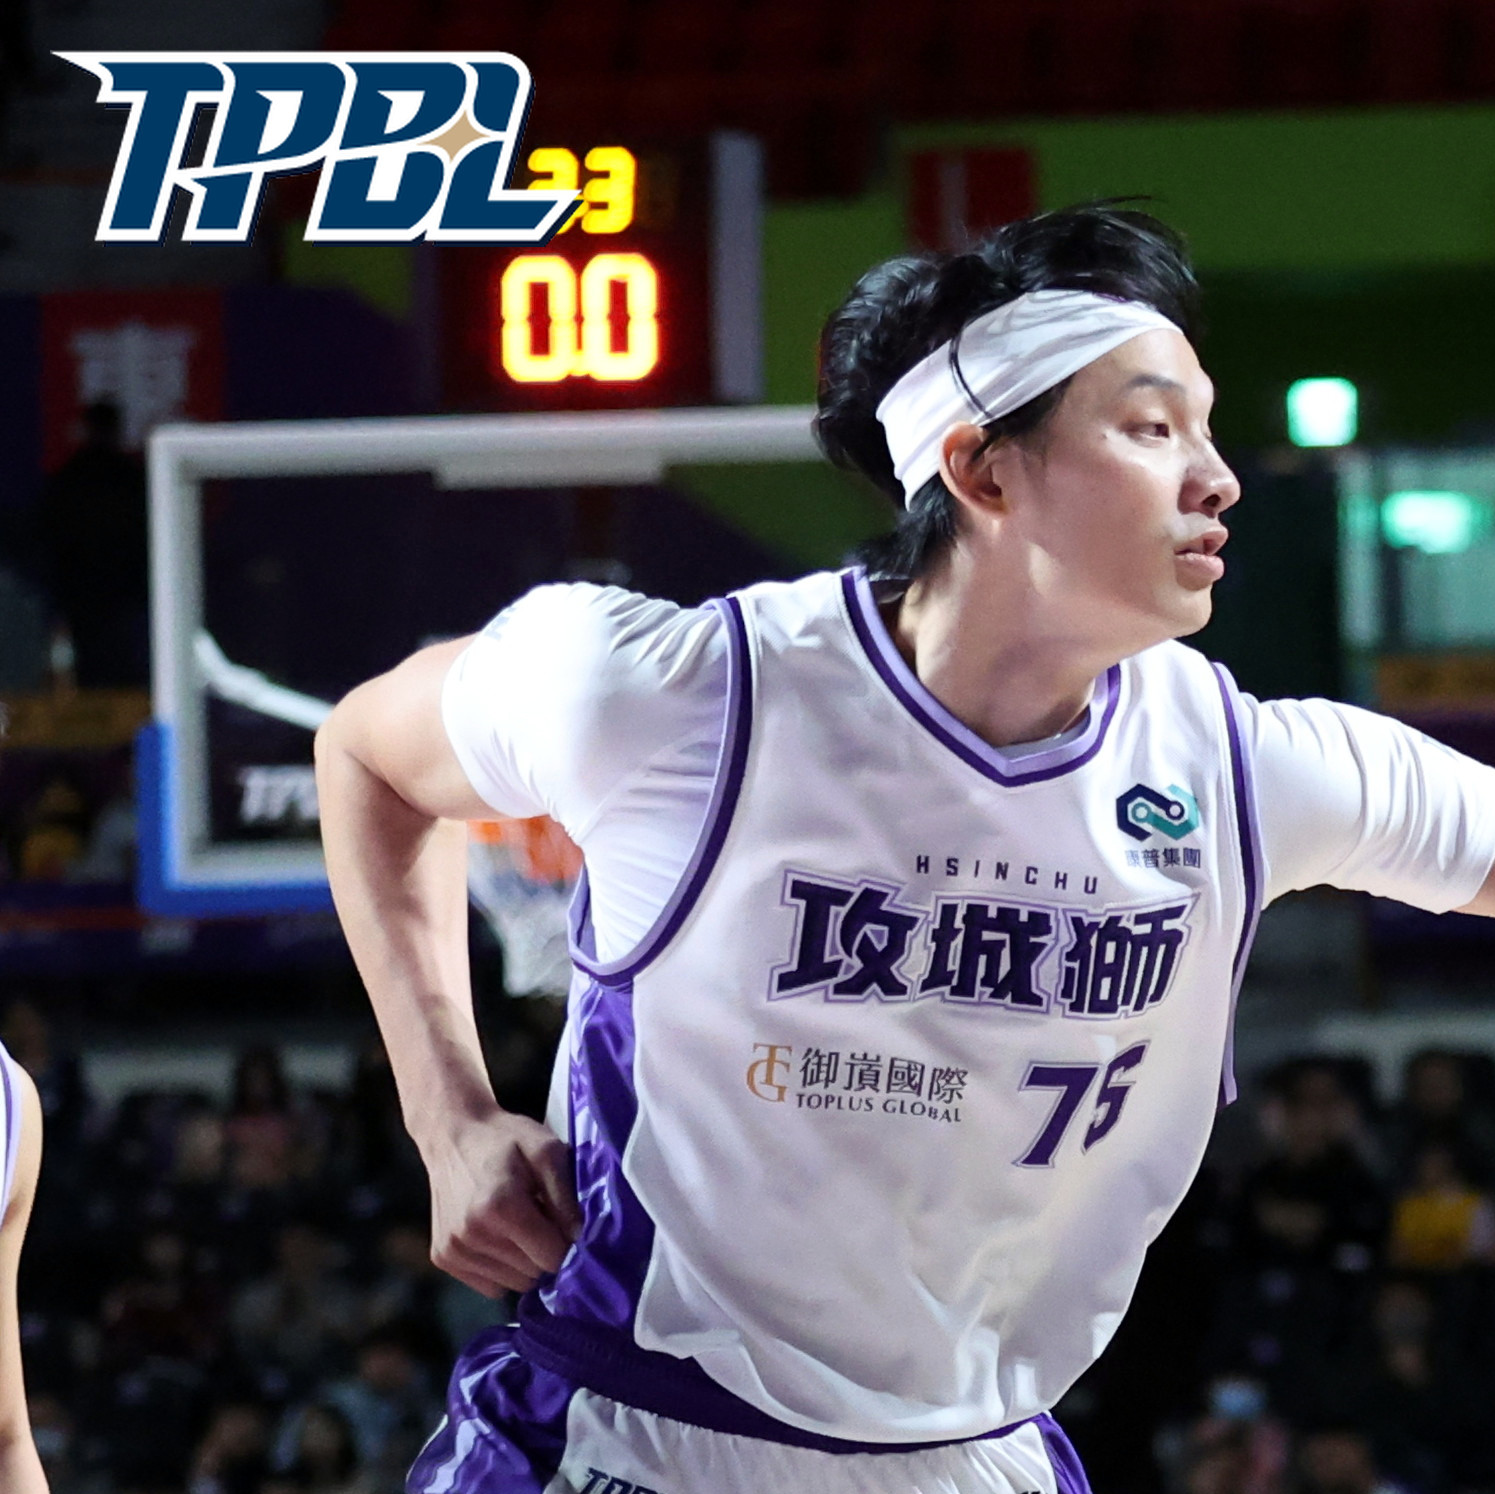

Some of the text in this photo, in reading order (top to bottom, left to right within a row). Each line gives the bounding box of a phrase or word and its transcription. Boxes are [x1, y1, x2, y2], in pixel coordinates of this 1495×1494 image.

[916, 855, 1098, 894] HSINCHU
[770, 872, 1196, 1018] 攻城獅
[796, 1093, 962, 1123] TOPLUS GLOBAL
[1011, 1039, 1151, 1168] 75
